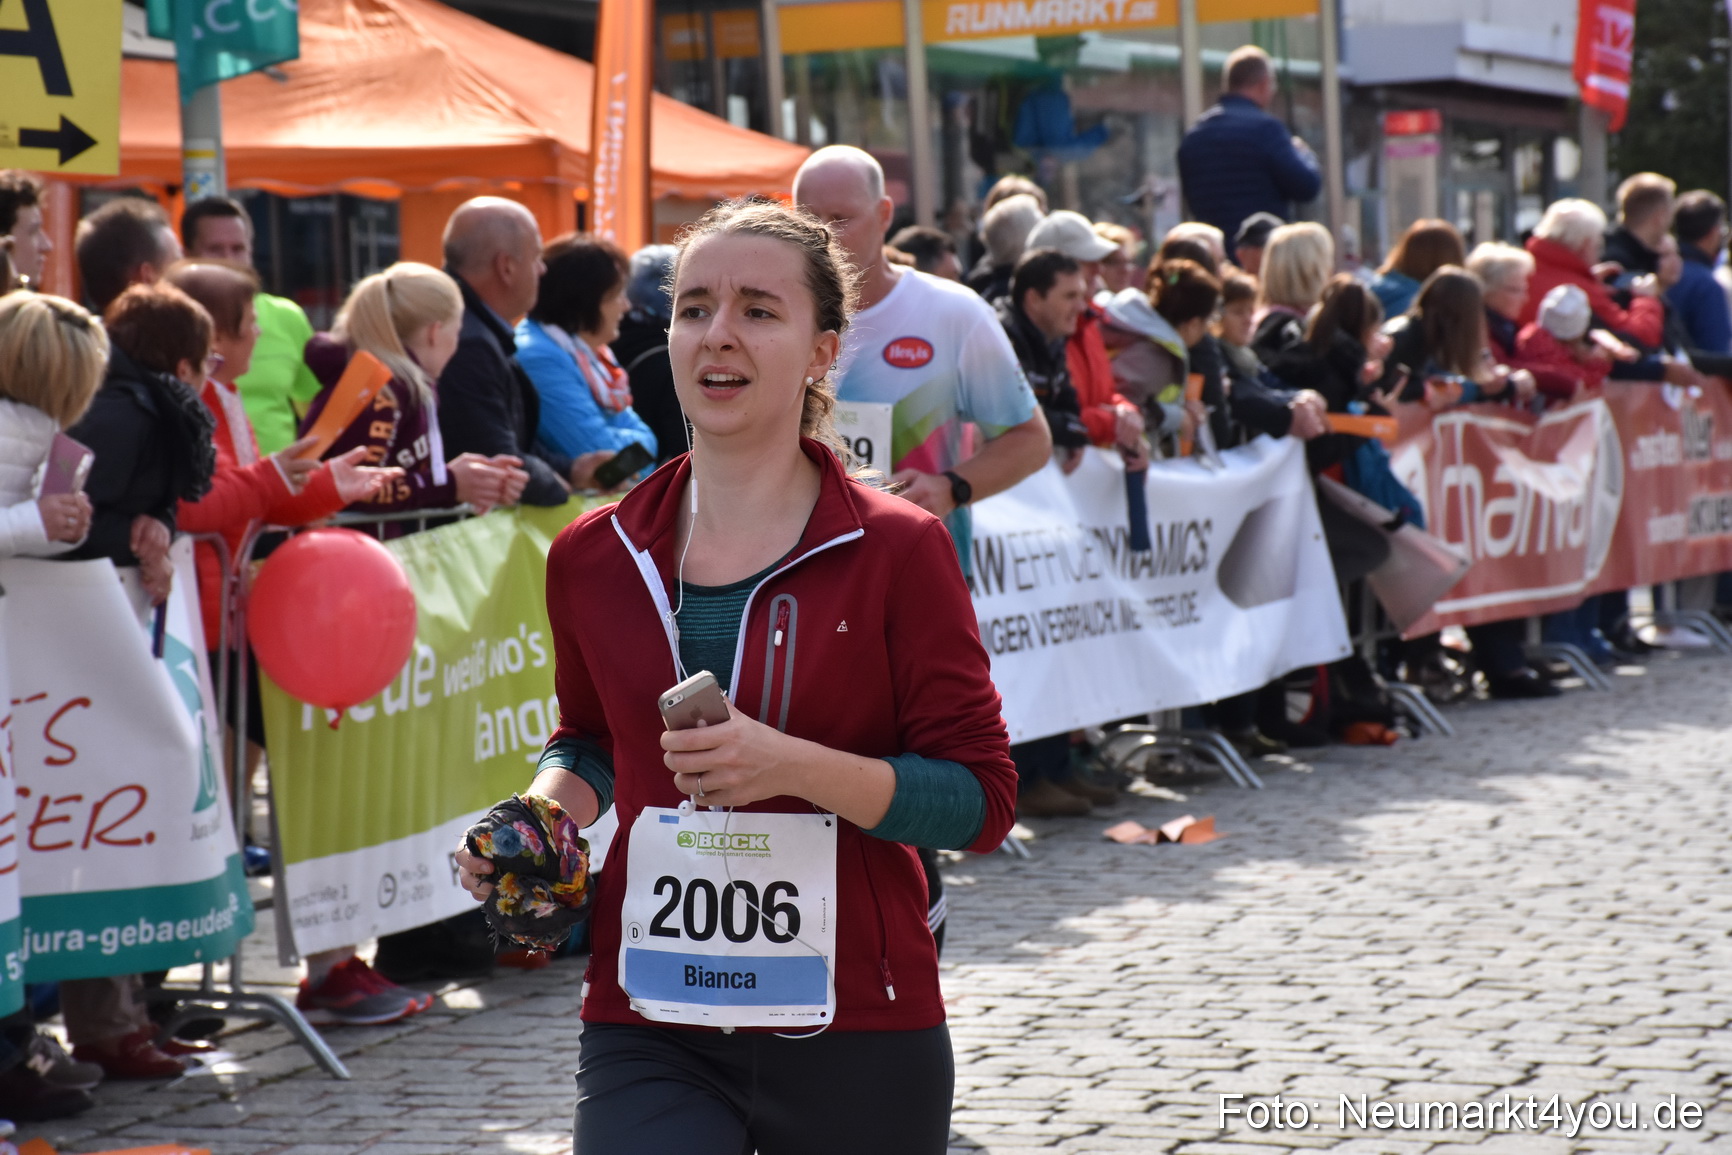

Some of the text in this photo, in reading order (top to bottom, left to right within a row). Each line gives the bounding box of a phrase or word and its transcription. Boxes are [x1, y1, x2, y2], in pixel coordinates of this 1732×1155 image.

[697, 832, 771, 852] BOCK
[696, 850, 717, 858] inspired
[649, 875, 801, 944] 2006
[632, 927, 639, 939] D
[684, 964, 757, 989] Bianca
